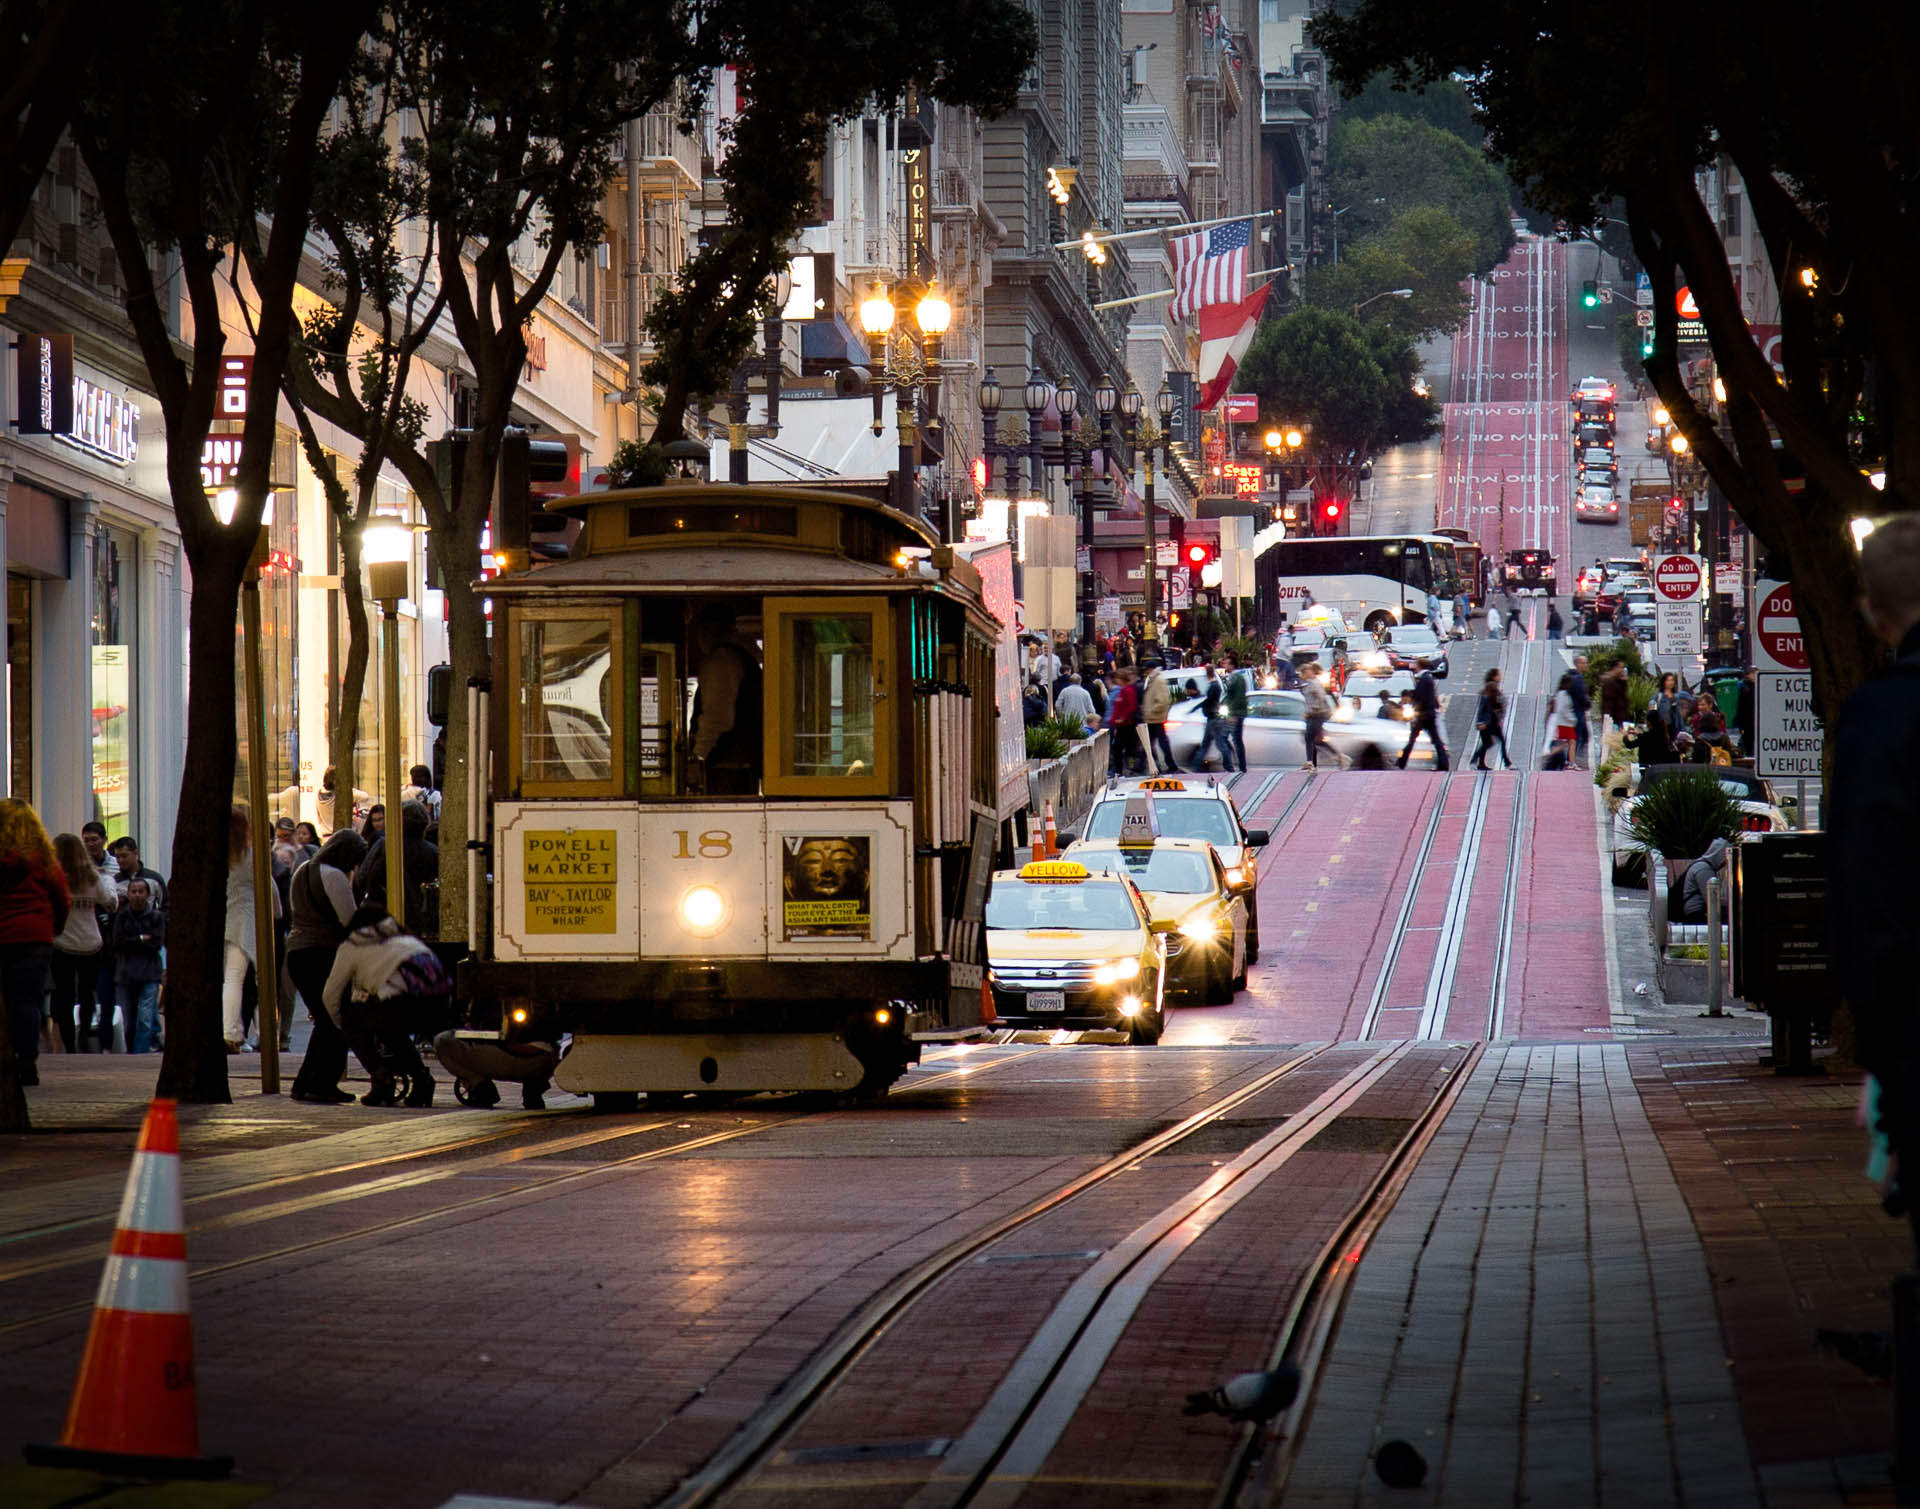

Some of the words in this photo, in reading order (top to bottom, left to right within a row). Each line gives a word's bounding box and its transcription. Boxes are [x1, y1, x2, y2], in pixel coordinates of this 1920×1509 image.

[1453, 407, 1500, 417] MUNI
[1507, 407, 1560, 416] ONLY
[73, 375, 140, 462] KECHERS
[1510, 433, 1559, 442] MUNI
[1448, 475, 1498, 484] MUNI
[1505, 474, 1561, 483] ONLY
[1509, 505, 1560, 514] MUNI
[1661, 563, 1675, 573] DO
[1678, 563, 1695, 572] NOT
[1279, 585, 1307, 599] ours
[1665, 583, 1692, 592] ENTER
[1770, 598, 1793, 613] DO
[1776, 637, 1804, 652] ENT
[1775, 678, 1809, 693] EXCE
[1784, 698, 1812, 713] MUN
[1769, 757, 1823, 772] VEHICLE
[1143, 781, 1179, 790] TAXI
[1124, 816, 1148, 825] TAXI
[529, 839, 610, 852] POWELL
[672, 830, 733, 859] 18
[551, 852, 592, 862] AND
[527, 863, 612, 875] MARKET
[1028, 865, 1080, 876] YELLOW
[528, 888, 551, 903] BAY
[566, 887, 613, 902] TAYLOR
[535, 905, 605, 916] FISHERMANS
[551, 916, 588, 926] WHARF
